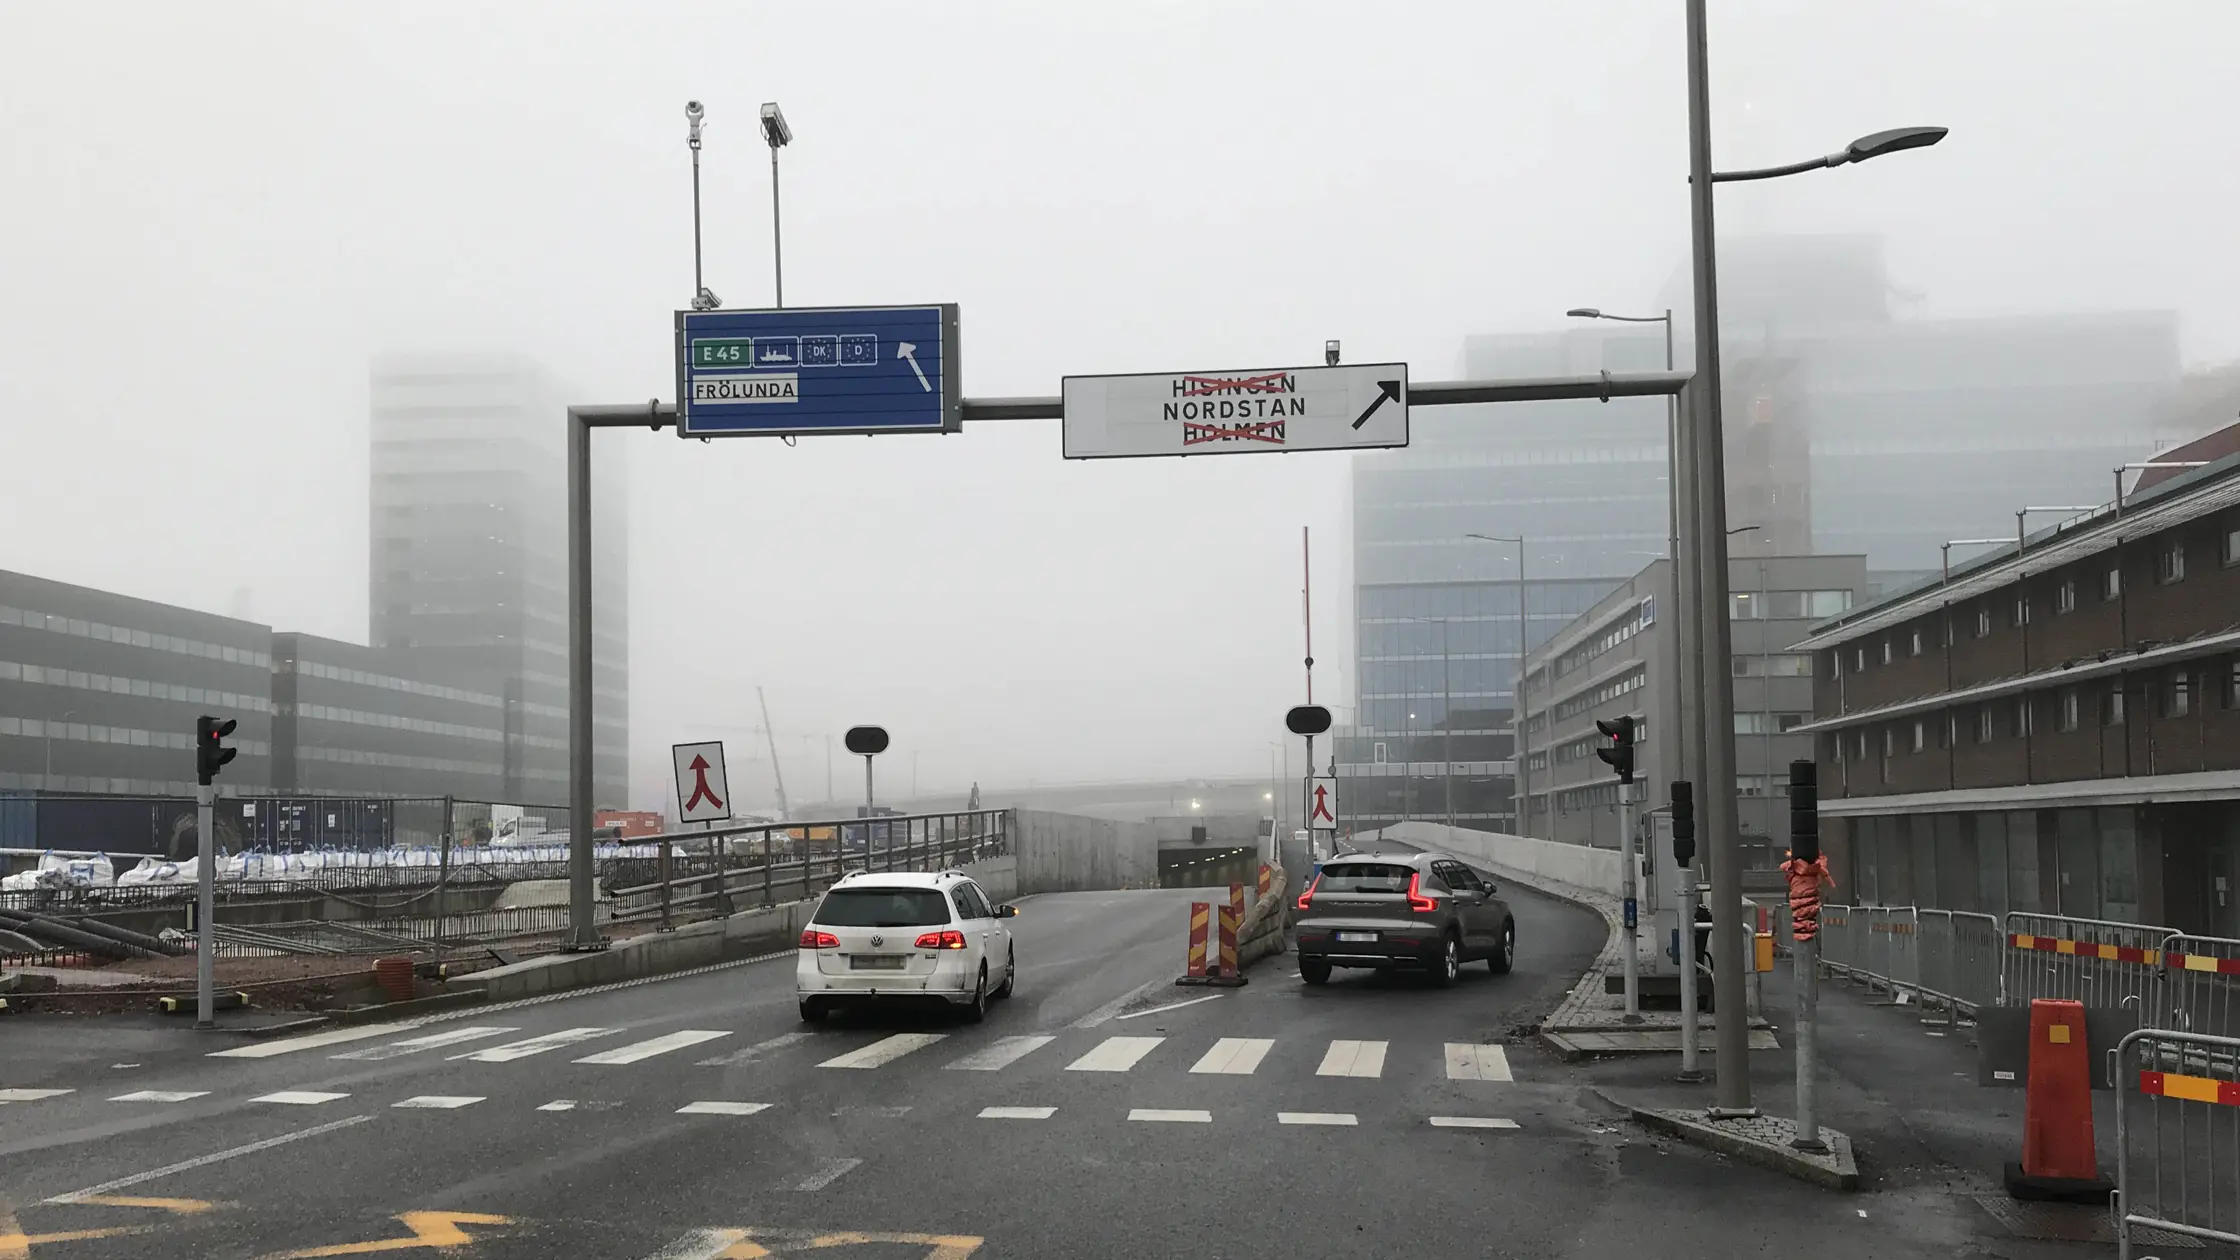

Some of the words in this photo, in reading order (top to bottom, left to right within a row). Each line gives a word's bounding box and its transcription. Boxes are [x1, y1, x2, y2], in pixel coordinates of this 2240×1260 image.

[703, 346, 712, 361] E
[716, 346, 740, 361] 45
[813, 346, 826, 357] DK
[854, 345, 863, 356] D
[696, 380, 795, 399] FRÖLUNDA
[1163, 397, 1305, 420] NORDSTAN
